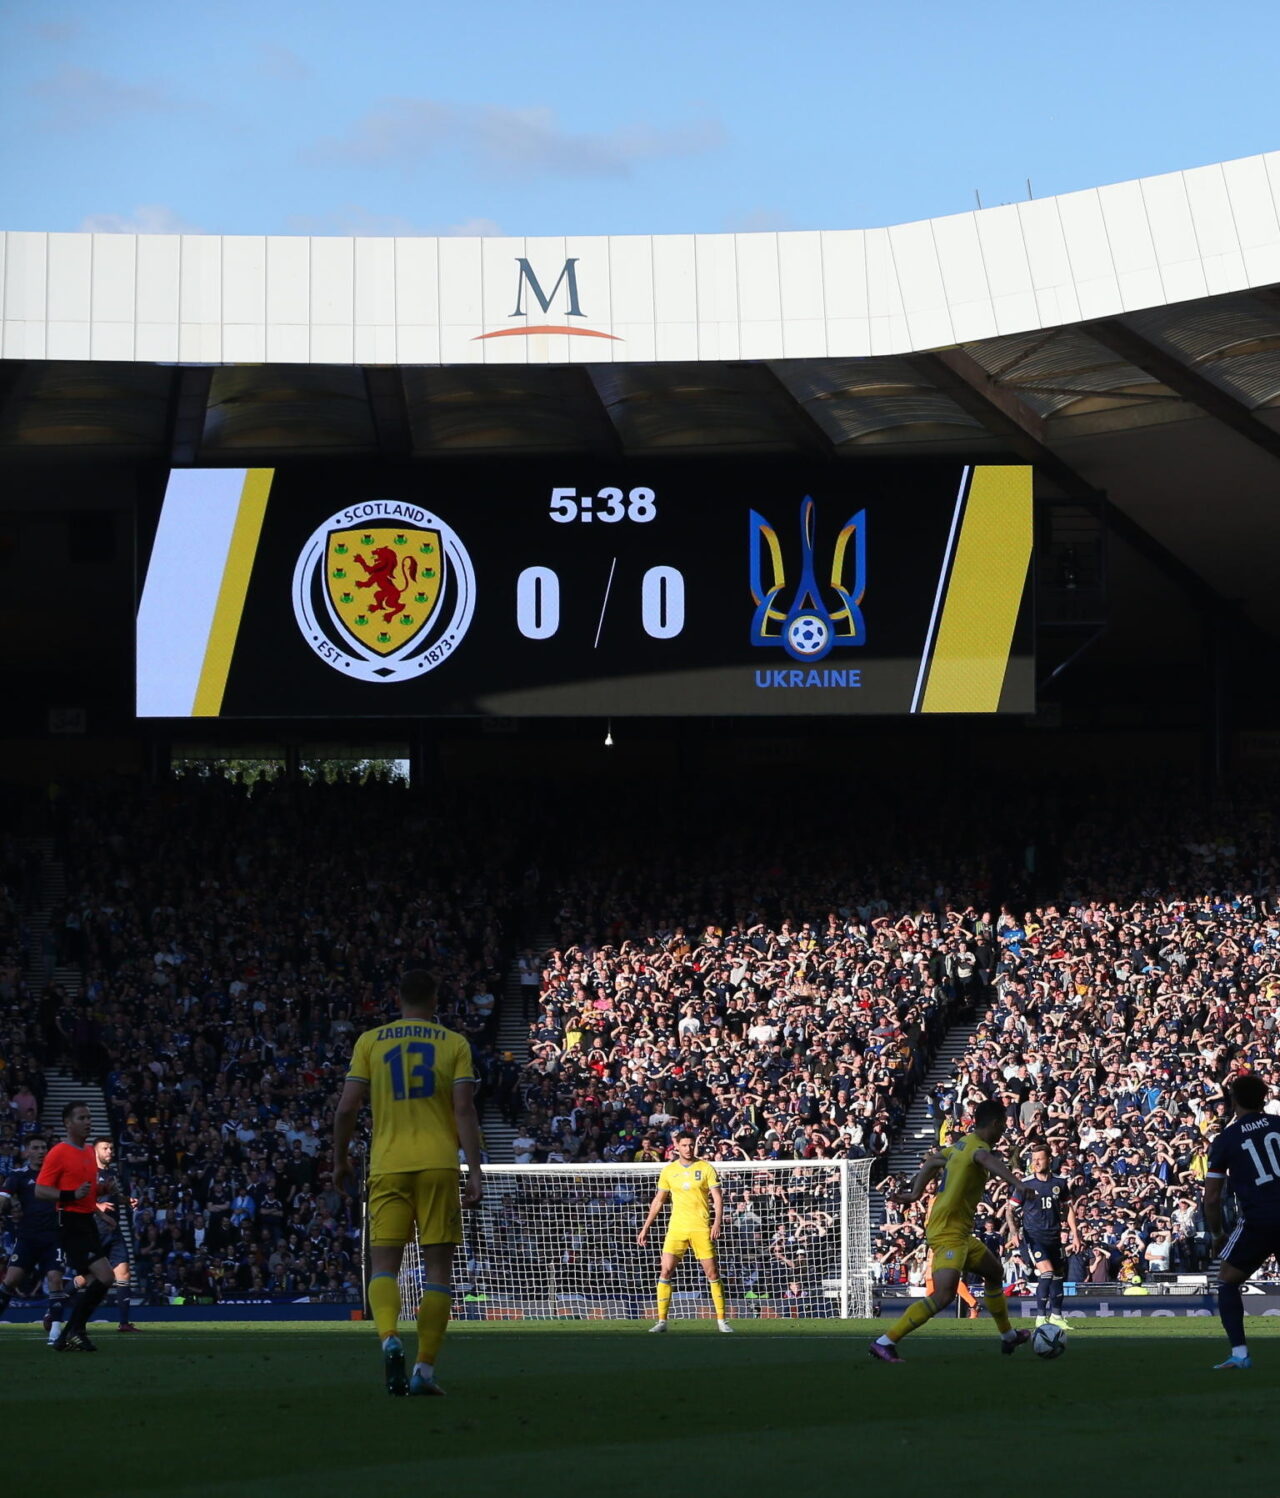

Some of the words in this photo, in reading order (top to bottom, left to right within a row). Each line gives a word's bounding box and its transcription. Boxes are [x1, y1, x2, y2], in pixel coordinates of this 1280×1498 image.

[508, 258, 588, 317] M
[344, 503, 425, 523] SCOTLAND
[550, 487, 657, 523] 5:38
[516, 565, 560, 640] 0
[641, 565, 685, 639] 0
[317, 640, 343, 664] EST
[423, 639, 453, 665] 1873
[755, 669, 862, 689] UKRAINE
[377, 1025, 447, 1041] ZABARNYI
[384, 1042, 435, 1101] 13
[1240, 1117, 1270, 1134] ADAMS
[694, 1170, 702, 1181] 9
[1041, 1197, 1052, 1210] 16
